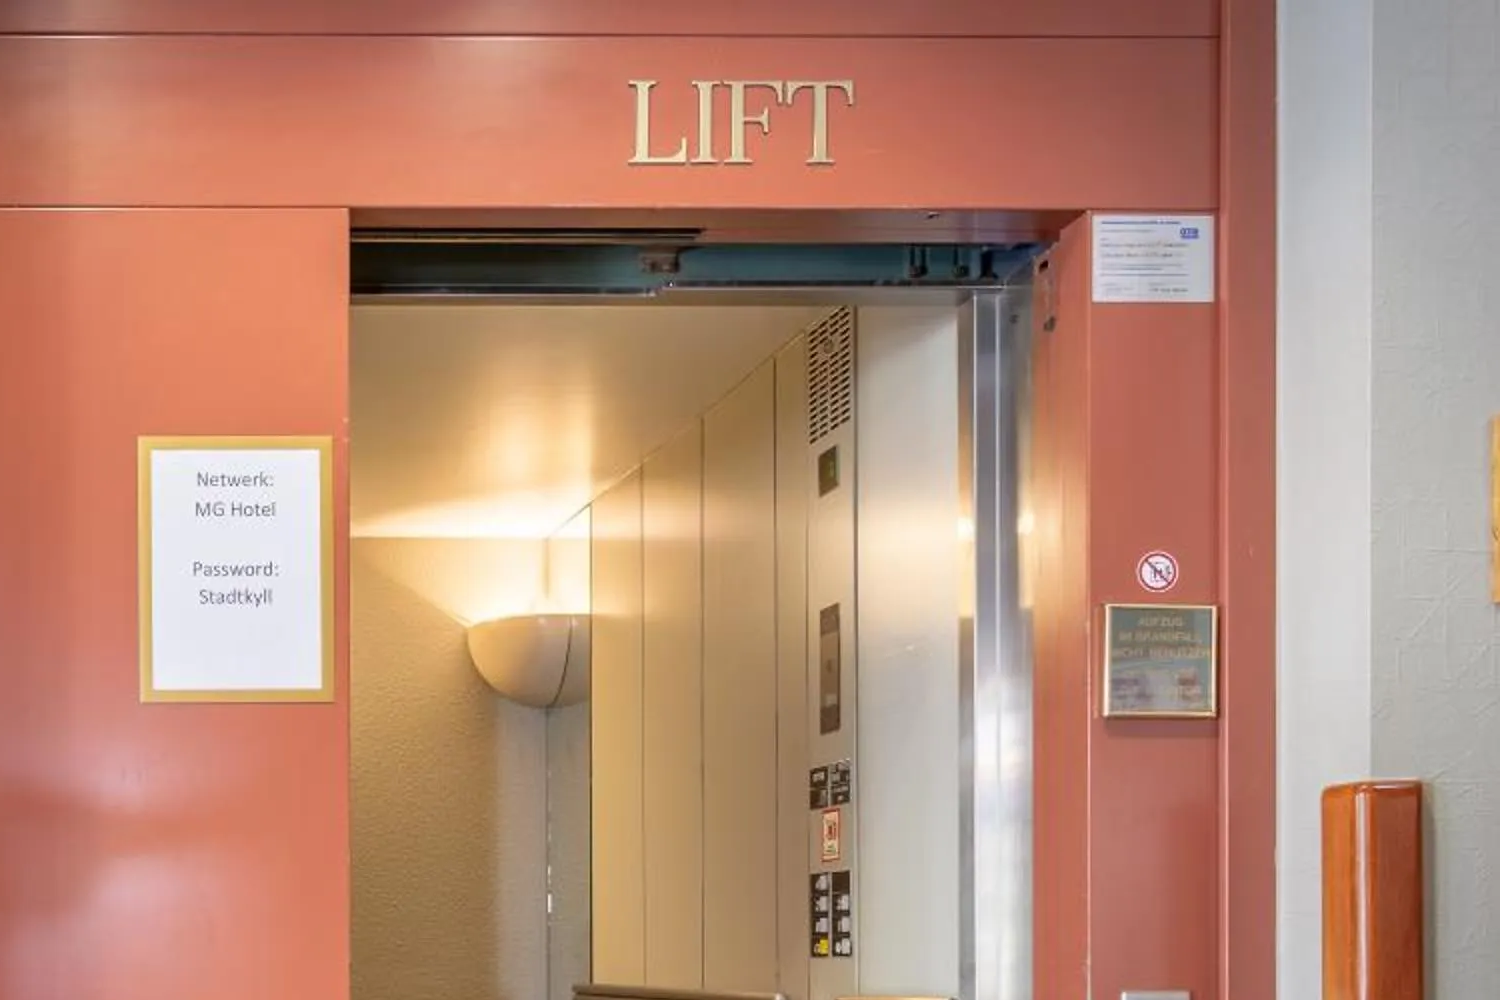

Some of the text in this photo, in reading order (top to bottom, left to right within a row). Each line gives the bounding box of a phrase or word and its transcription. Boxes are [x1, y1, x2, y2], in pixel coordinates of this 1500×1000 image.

[628, 80, 854, 165] LIFT
[196, 471, 274, 488] Netwerk:
[195, 501, 276, 517] MG Hotel
[192, 561, 279, 577] Password:
[199, 588, 273, 608] Stadtkyll
